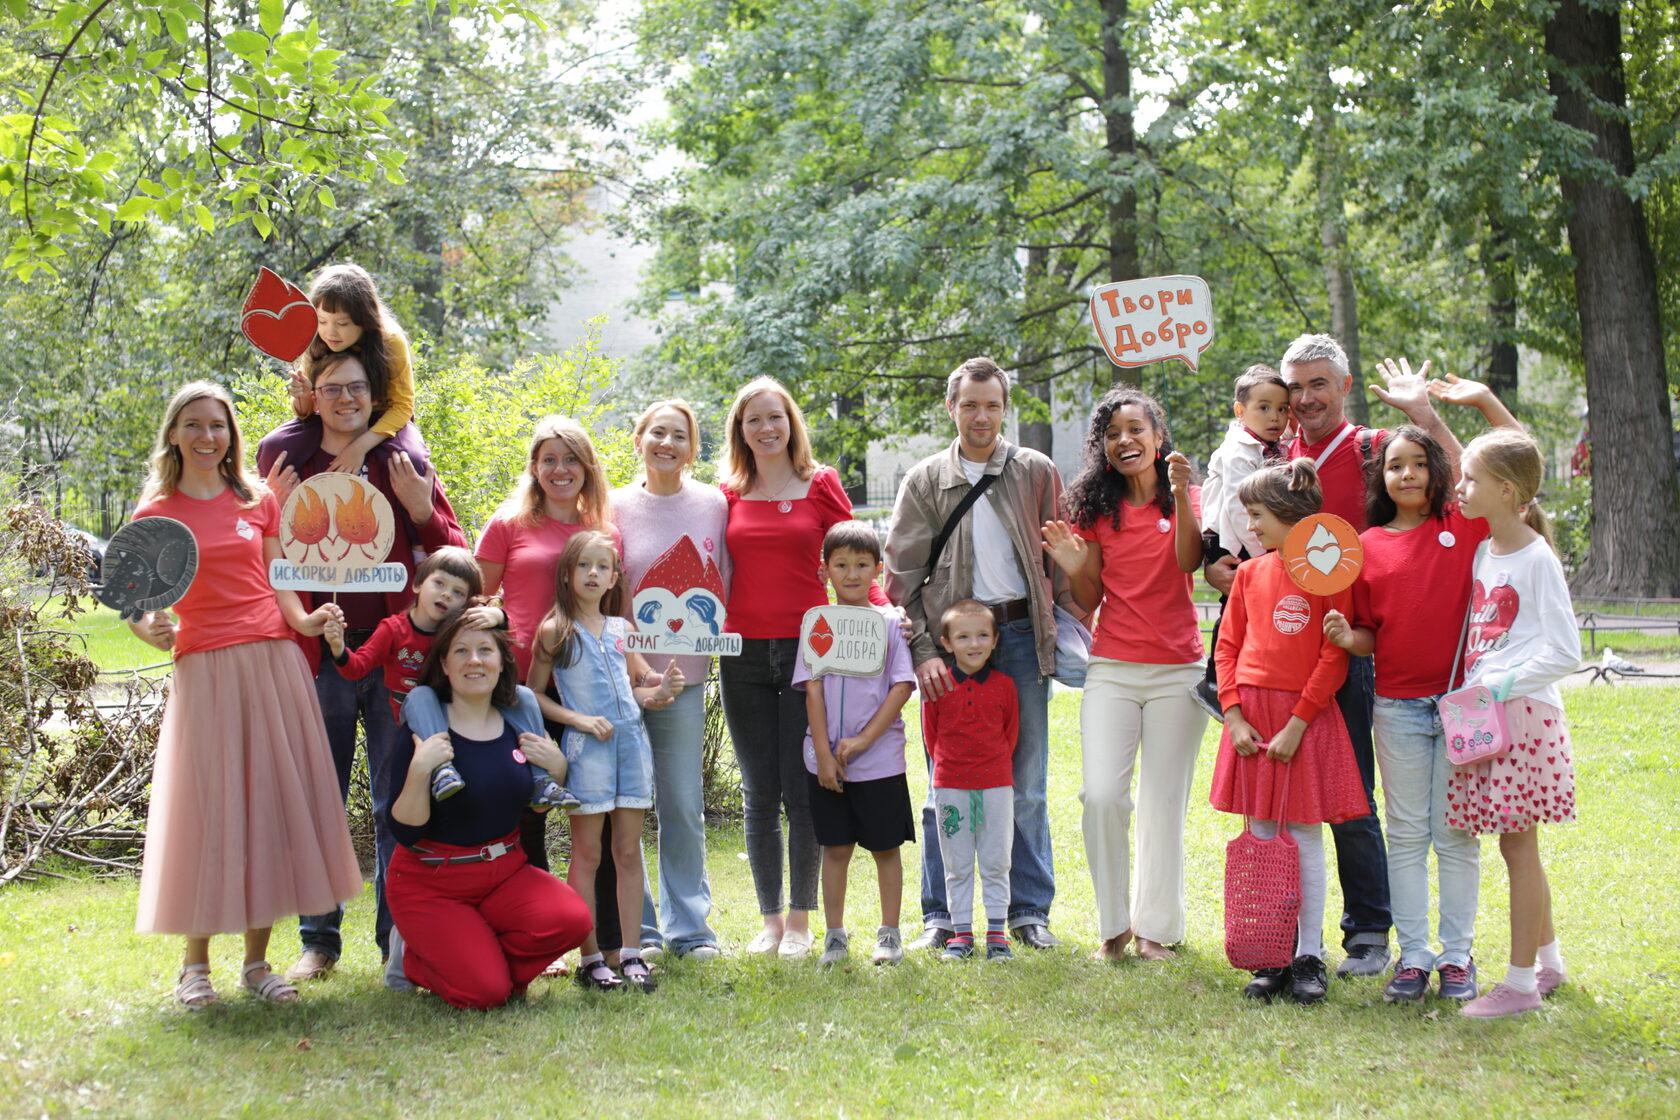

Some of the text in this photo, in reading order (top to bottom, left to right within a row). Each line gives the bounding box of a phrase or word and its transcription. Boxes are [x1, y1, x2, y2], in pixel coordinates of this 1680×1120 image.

[1100, 288, 1193, 318] Твори
[1114, 317, 1208, 357] Добро
[274, 565, 405, 584] ИСКОРКИ ДОБРОТЫ
[627, 634, 740, 653] ОЧАГ ДОБРОТЫ
[835, 640, 876, 661] ДОБРА
